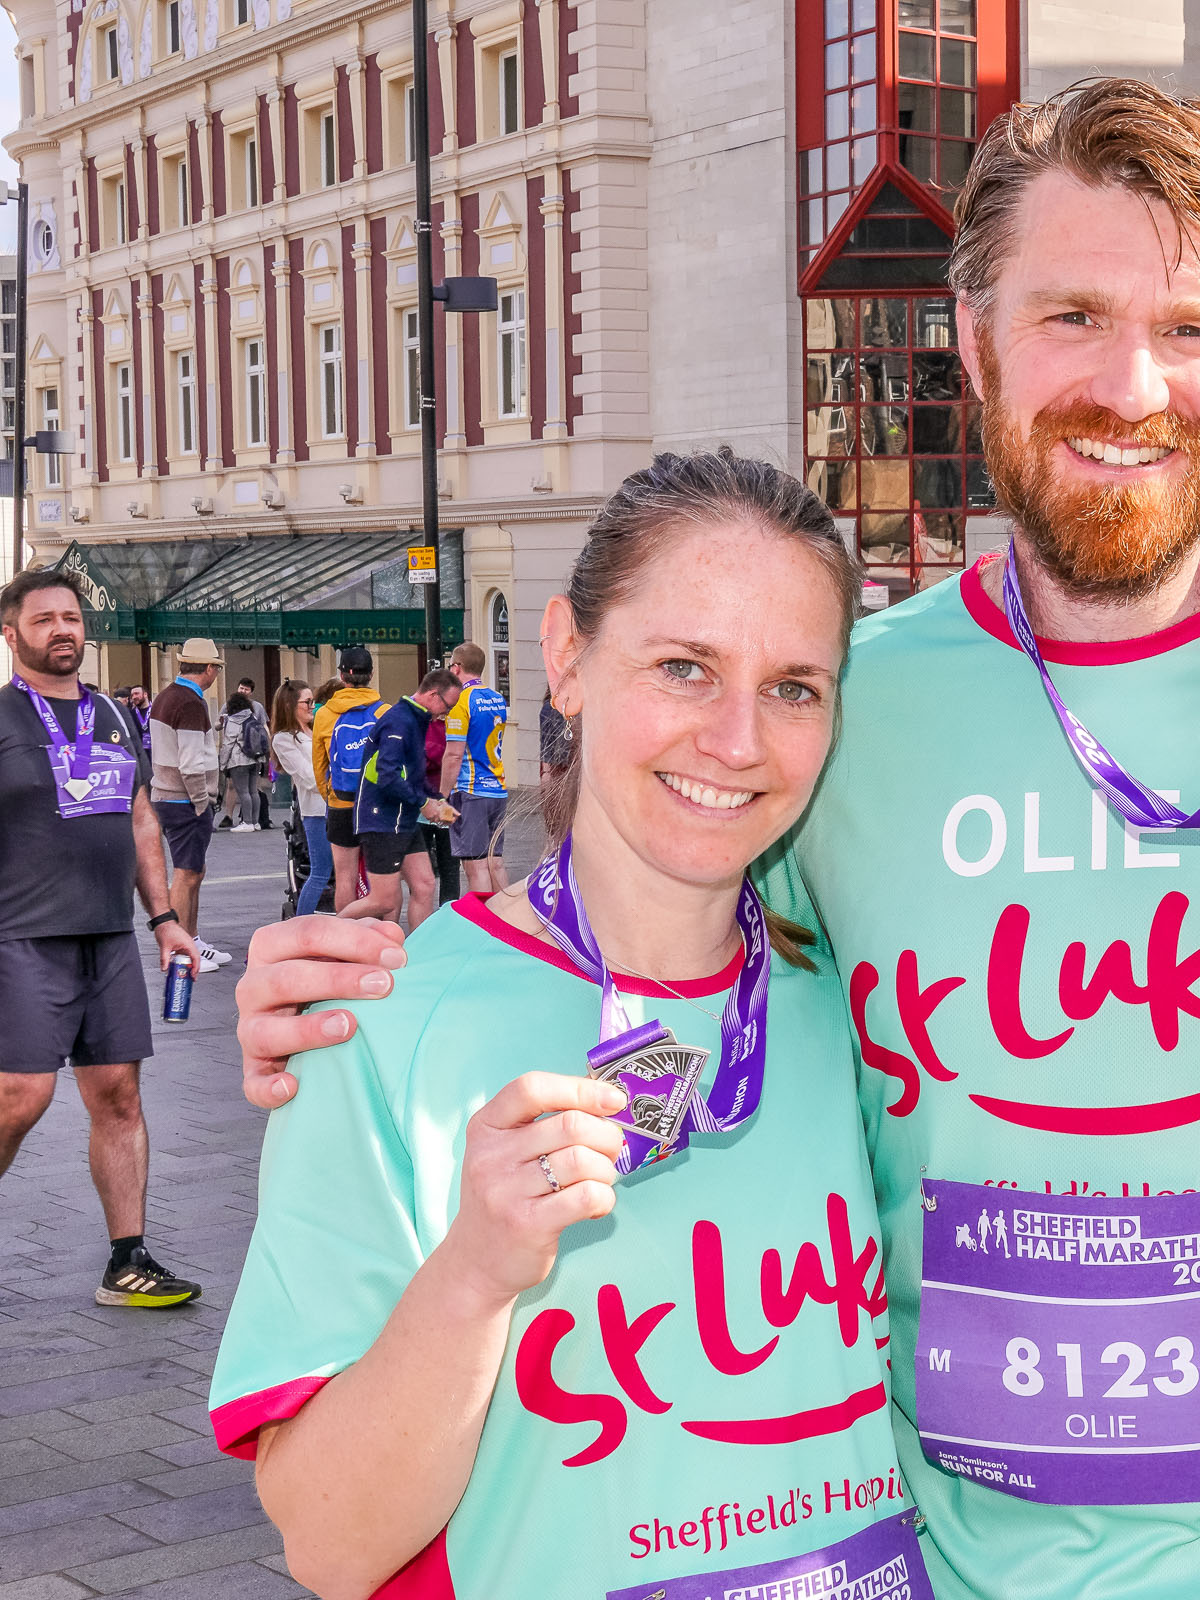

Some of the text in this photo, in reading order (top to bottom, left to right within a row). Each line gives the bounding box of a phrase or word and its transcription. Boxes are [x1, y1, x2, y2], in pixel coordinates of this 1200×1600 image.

[87, 769, 121, 787] 971
[942, 789, 1180, 877] OLIE
[849, 949, 966, 1118] St
[1016, 1211, 1138, 1240] SHEFFIELD
[1016, 1236, 1079, 1263] HALF
[515, 1284, 676, 1467] St
[929, 1348, 951, 1373] M
[1002, 1336, 1200, 1398] 8123
[1065, 1413, 1138, 1439] OLIE
[938, 1451, 1008, 1471] Jane Tomlinson's
[940, 1458, 1036, 1489] RUN FOR ALL
[628, 1488, 813, 1560] Sheffield's
